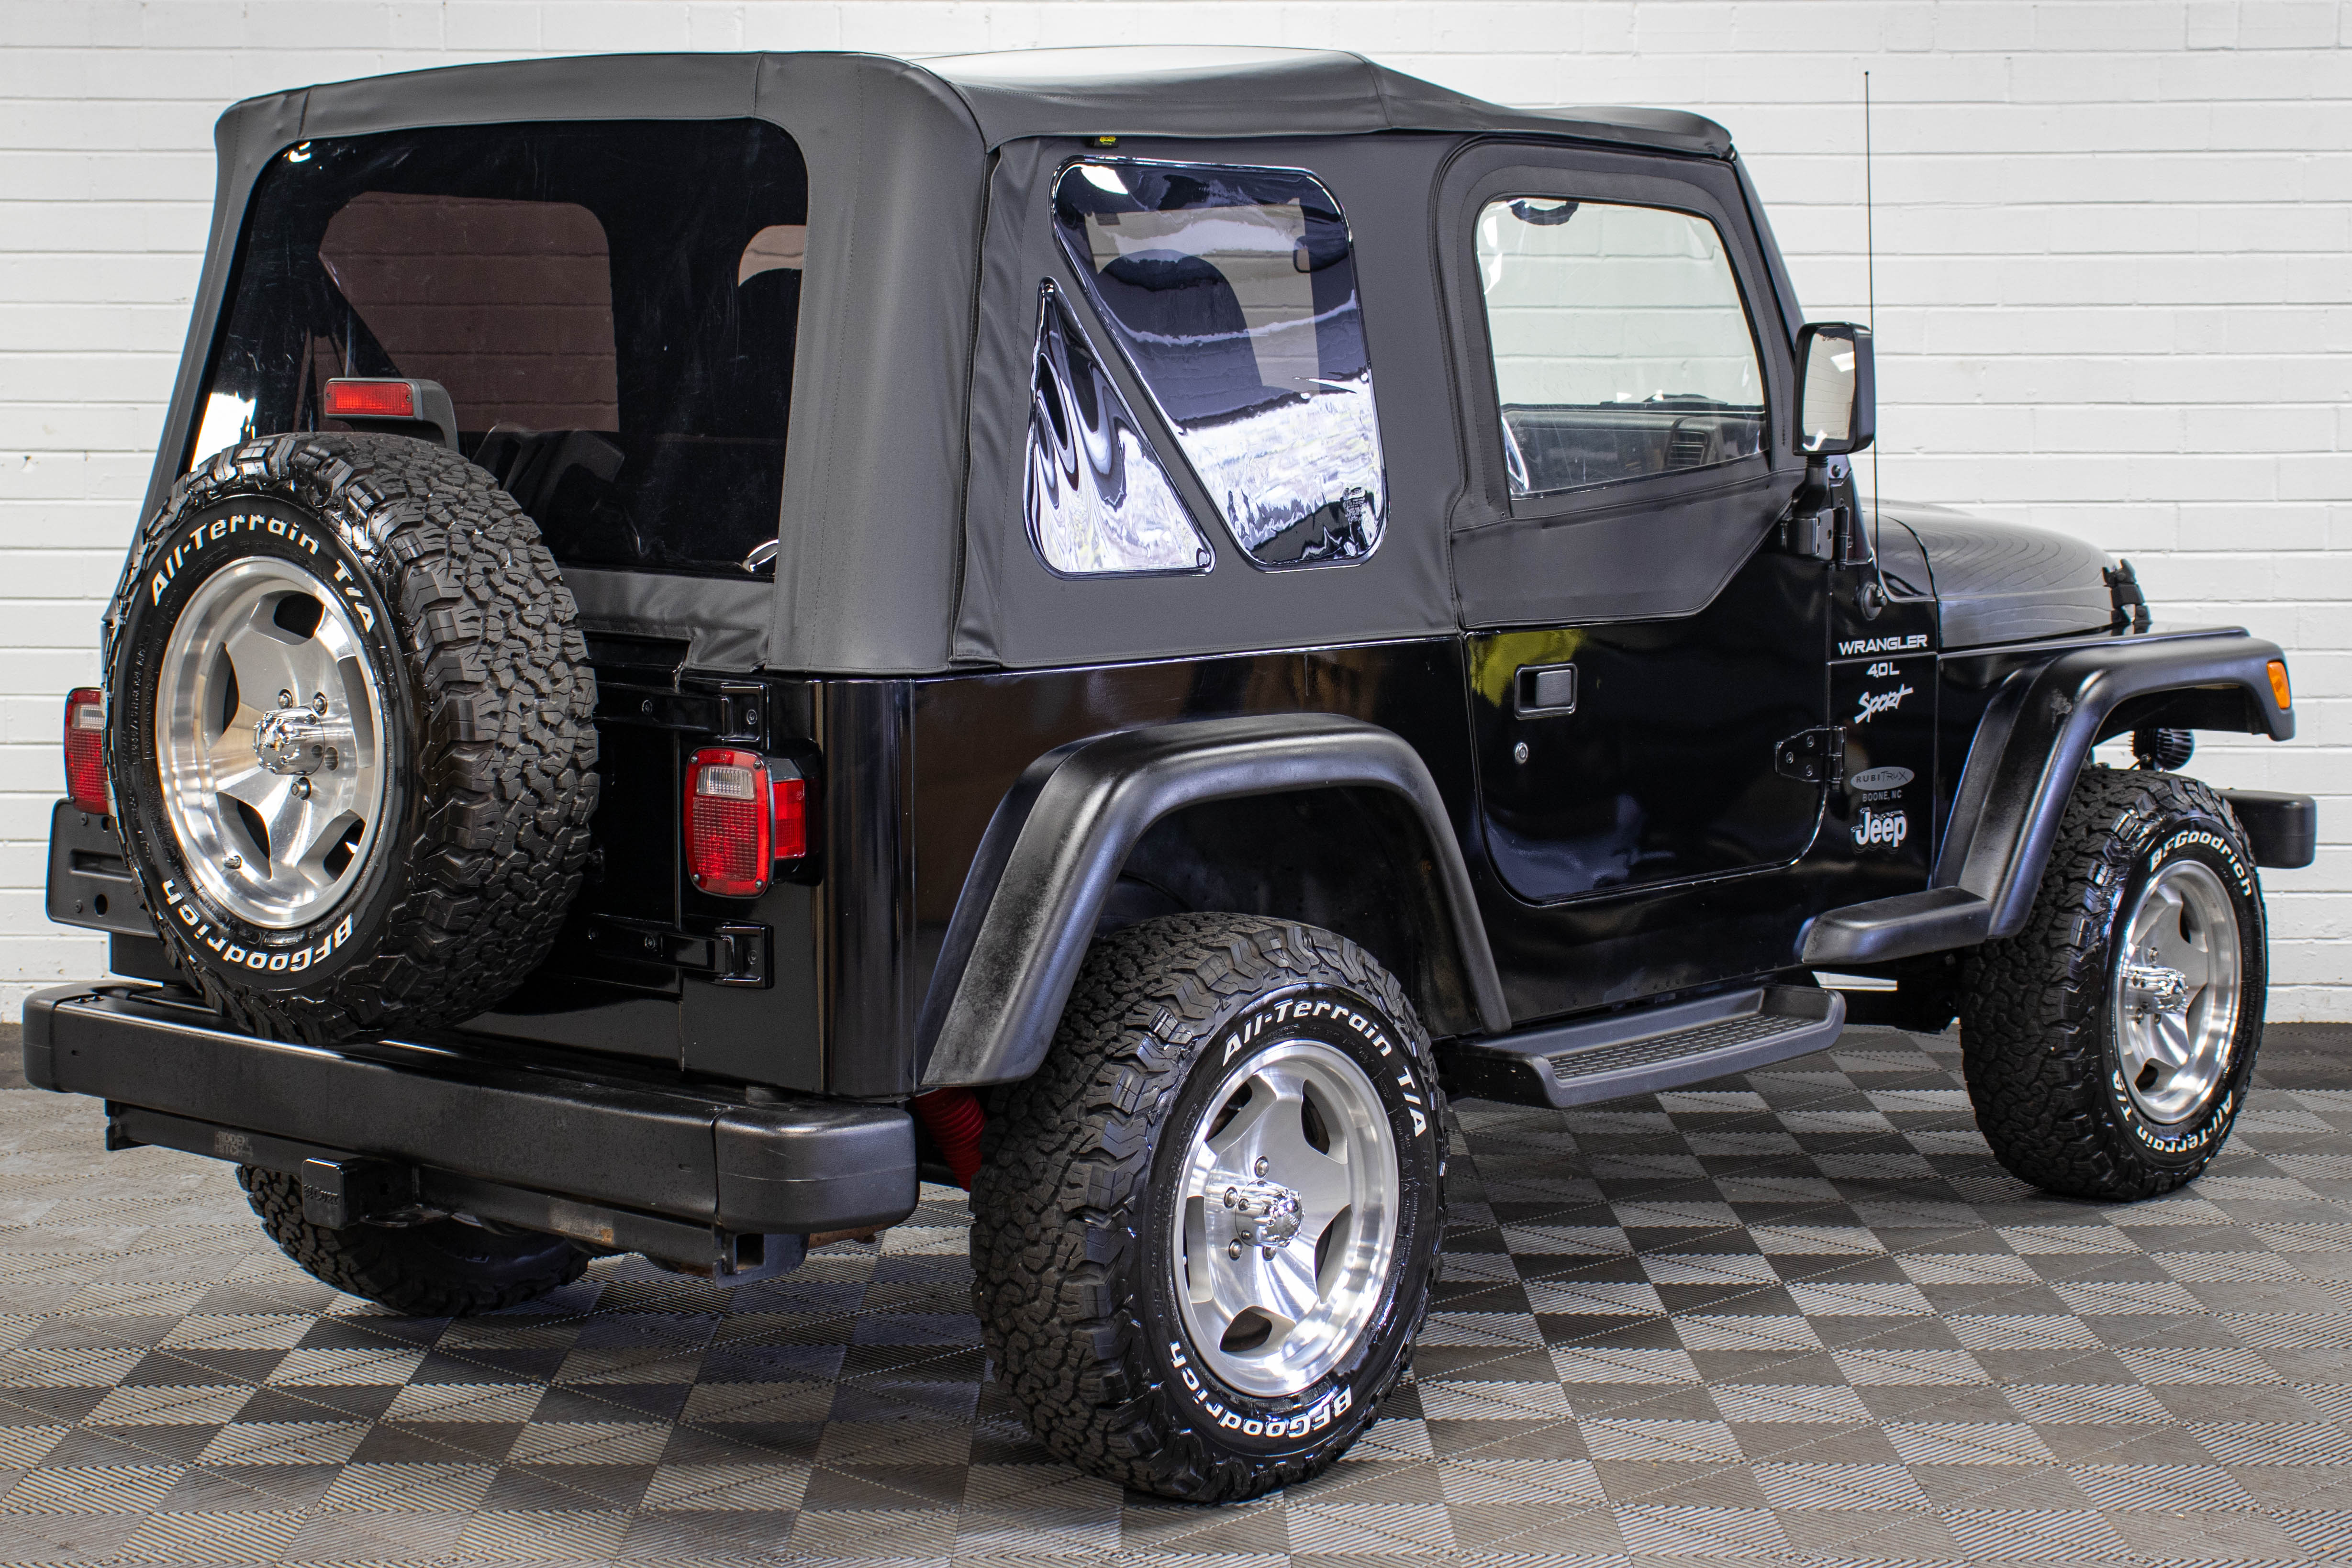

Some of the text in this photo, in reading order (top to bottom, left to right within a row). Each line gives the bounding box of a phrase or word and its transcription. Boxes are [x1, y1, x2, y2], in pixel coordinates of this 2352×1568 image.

[152, 514, 320, 607] All-Terrain
[334, 559, 376, 633] T/A
[1839, 634, 1928, 655] WRANGLER
[1852, 809, 1907, 847] Jeep
[1862, 790, 1902, 802] BOONE, NC
[2150, 830, 2252, 896] BFGoodrich
[162, 879, 354, 972] BFGoodrich
[1222, 999, 1393, 1067] All-Terrain
[1397, 1066, 1427, 1137] T/A
[2112, 1069, 2232, 1153] All-Terrain T/A
[1169, 1341, 1352, 1438] BFGoodrich
